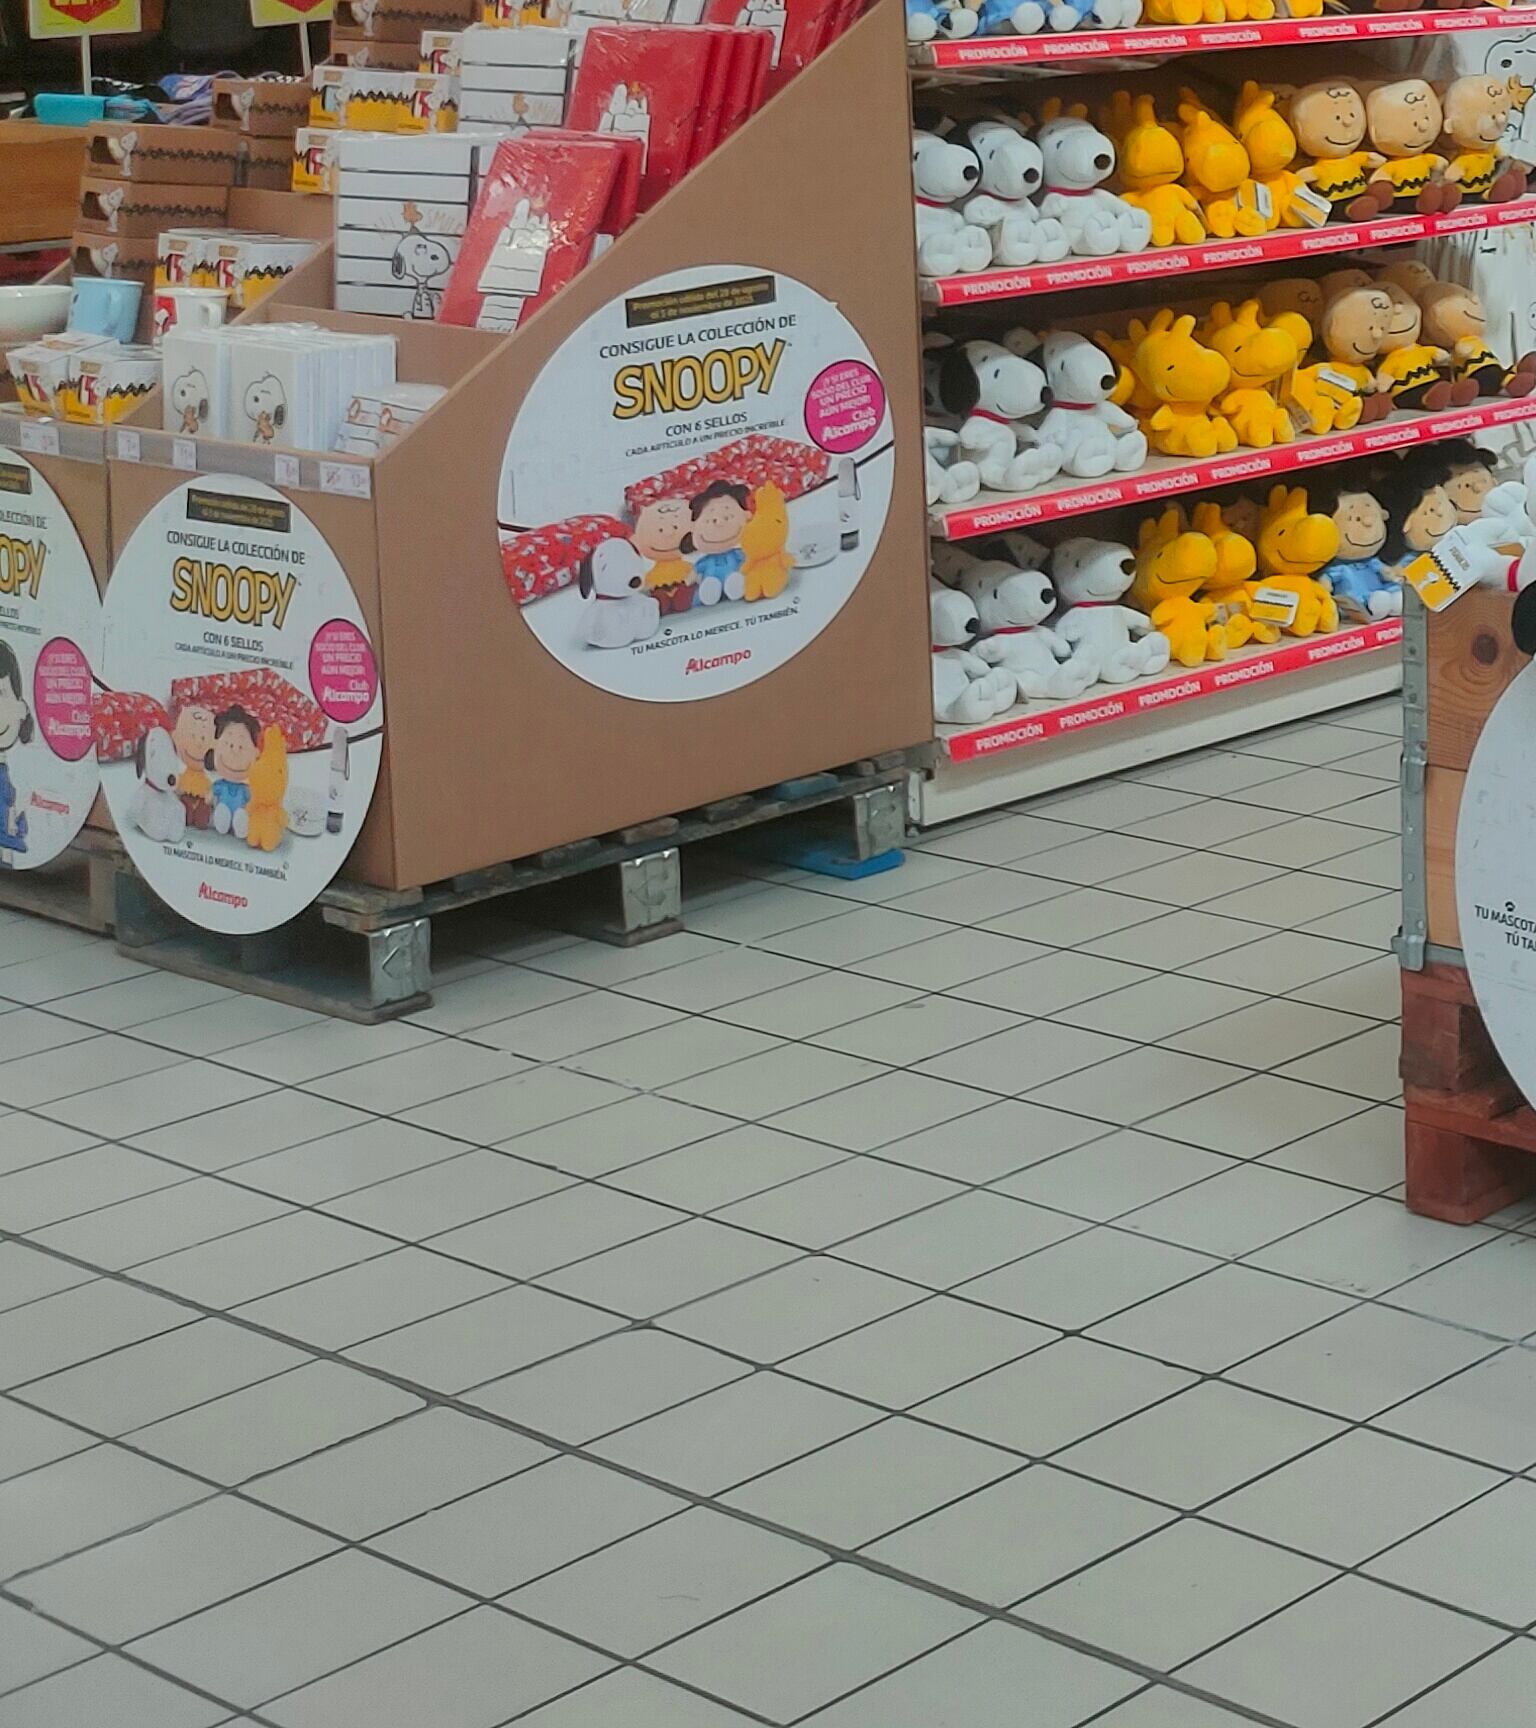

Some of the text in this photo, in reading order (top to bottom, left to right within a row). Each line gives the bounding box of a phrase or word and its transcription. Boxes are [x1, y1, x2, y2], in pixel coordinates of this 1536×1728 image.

[959, 39, 1110, 61] PROMOCIÓN PROMOCIÓN
[963, 265, 1112, 296] PROMOCIÓN PROMOCIÓN
[600, 315, 797, 359] CONSIGUE COLECCIÓN DE
[612, 337, 786, 420] SNOOPY
[705, 412, 748, 431] SELLOS
[170, 556, 296, 630] SNOOPY
[686, 649, 751, 675] Alcampo
